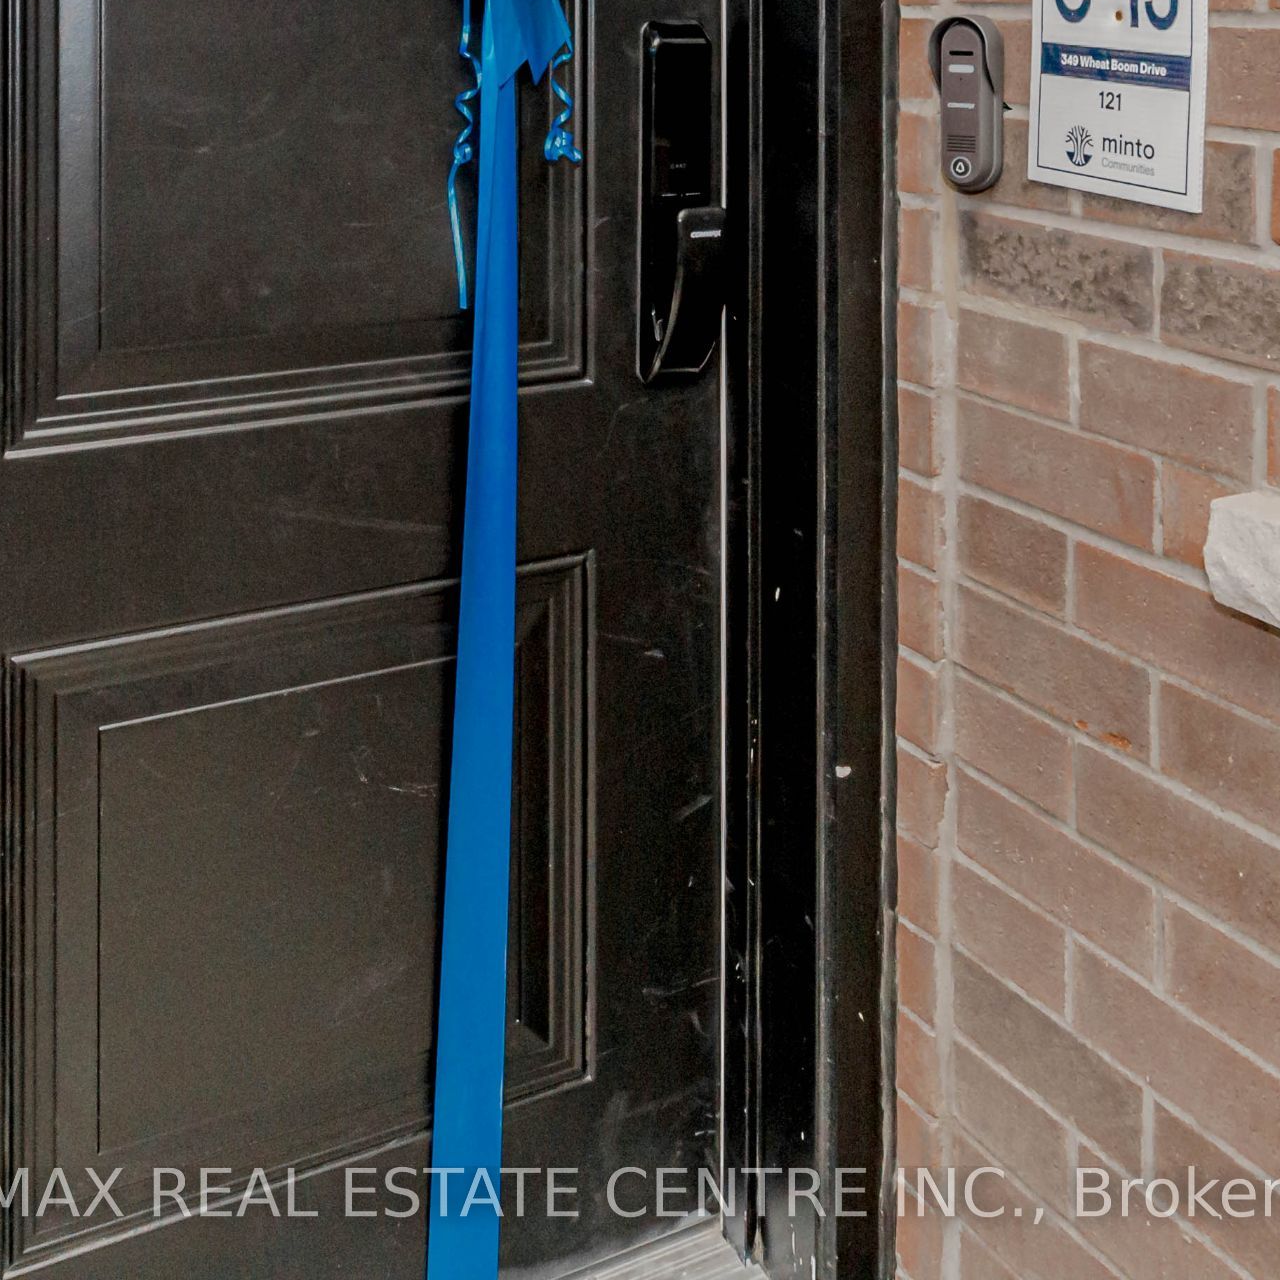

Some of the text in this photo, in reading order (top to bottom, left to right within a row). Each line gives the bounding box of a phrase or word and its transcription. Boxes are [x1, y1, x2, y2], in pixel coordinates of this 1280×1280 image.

[1061, 53, 1167, 76] 349 Wheat Boom Drive
[1098, 91, 1122, 111] 121
[1102, 134, 1155, 160] minto
